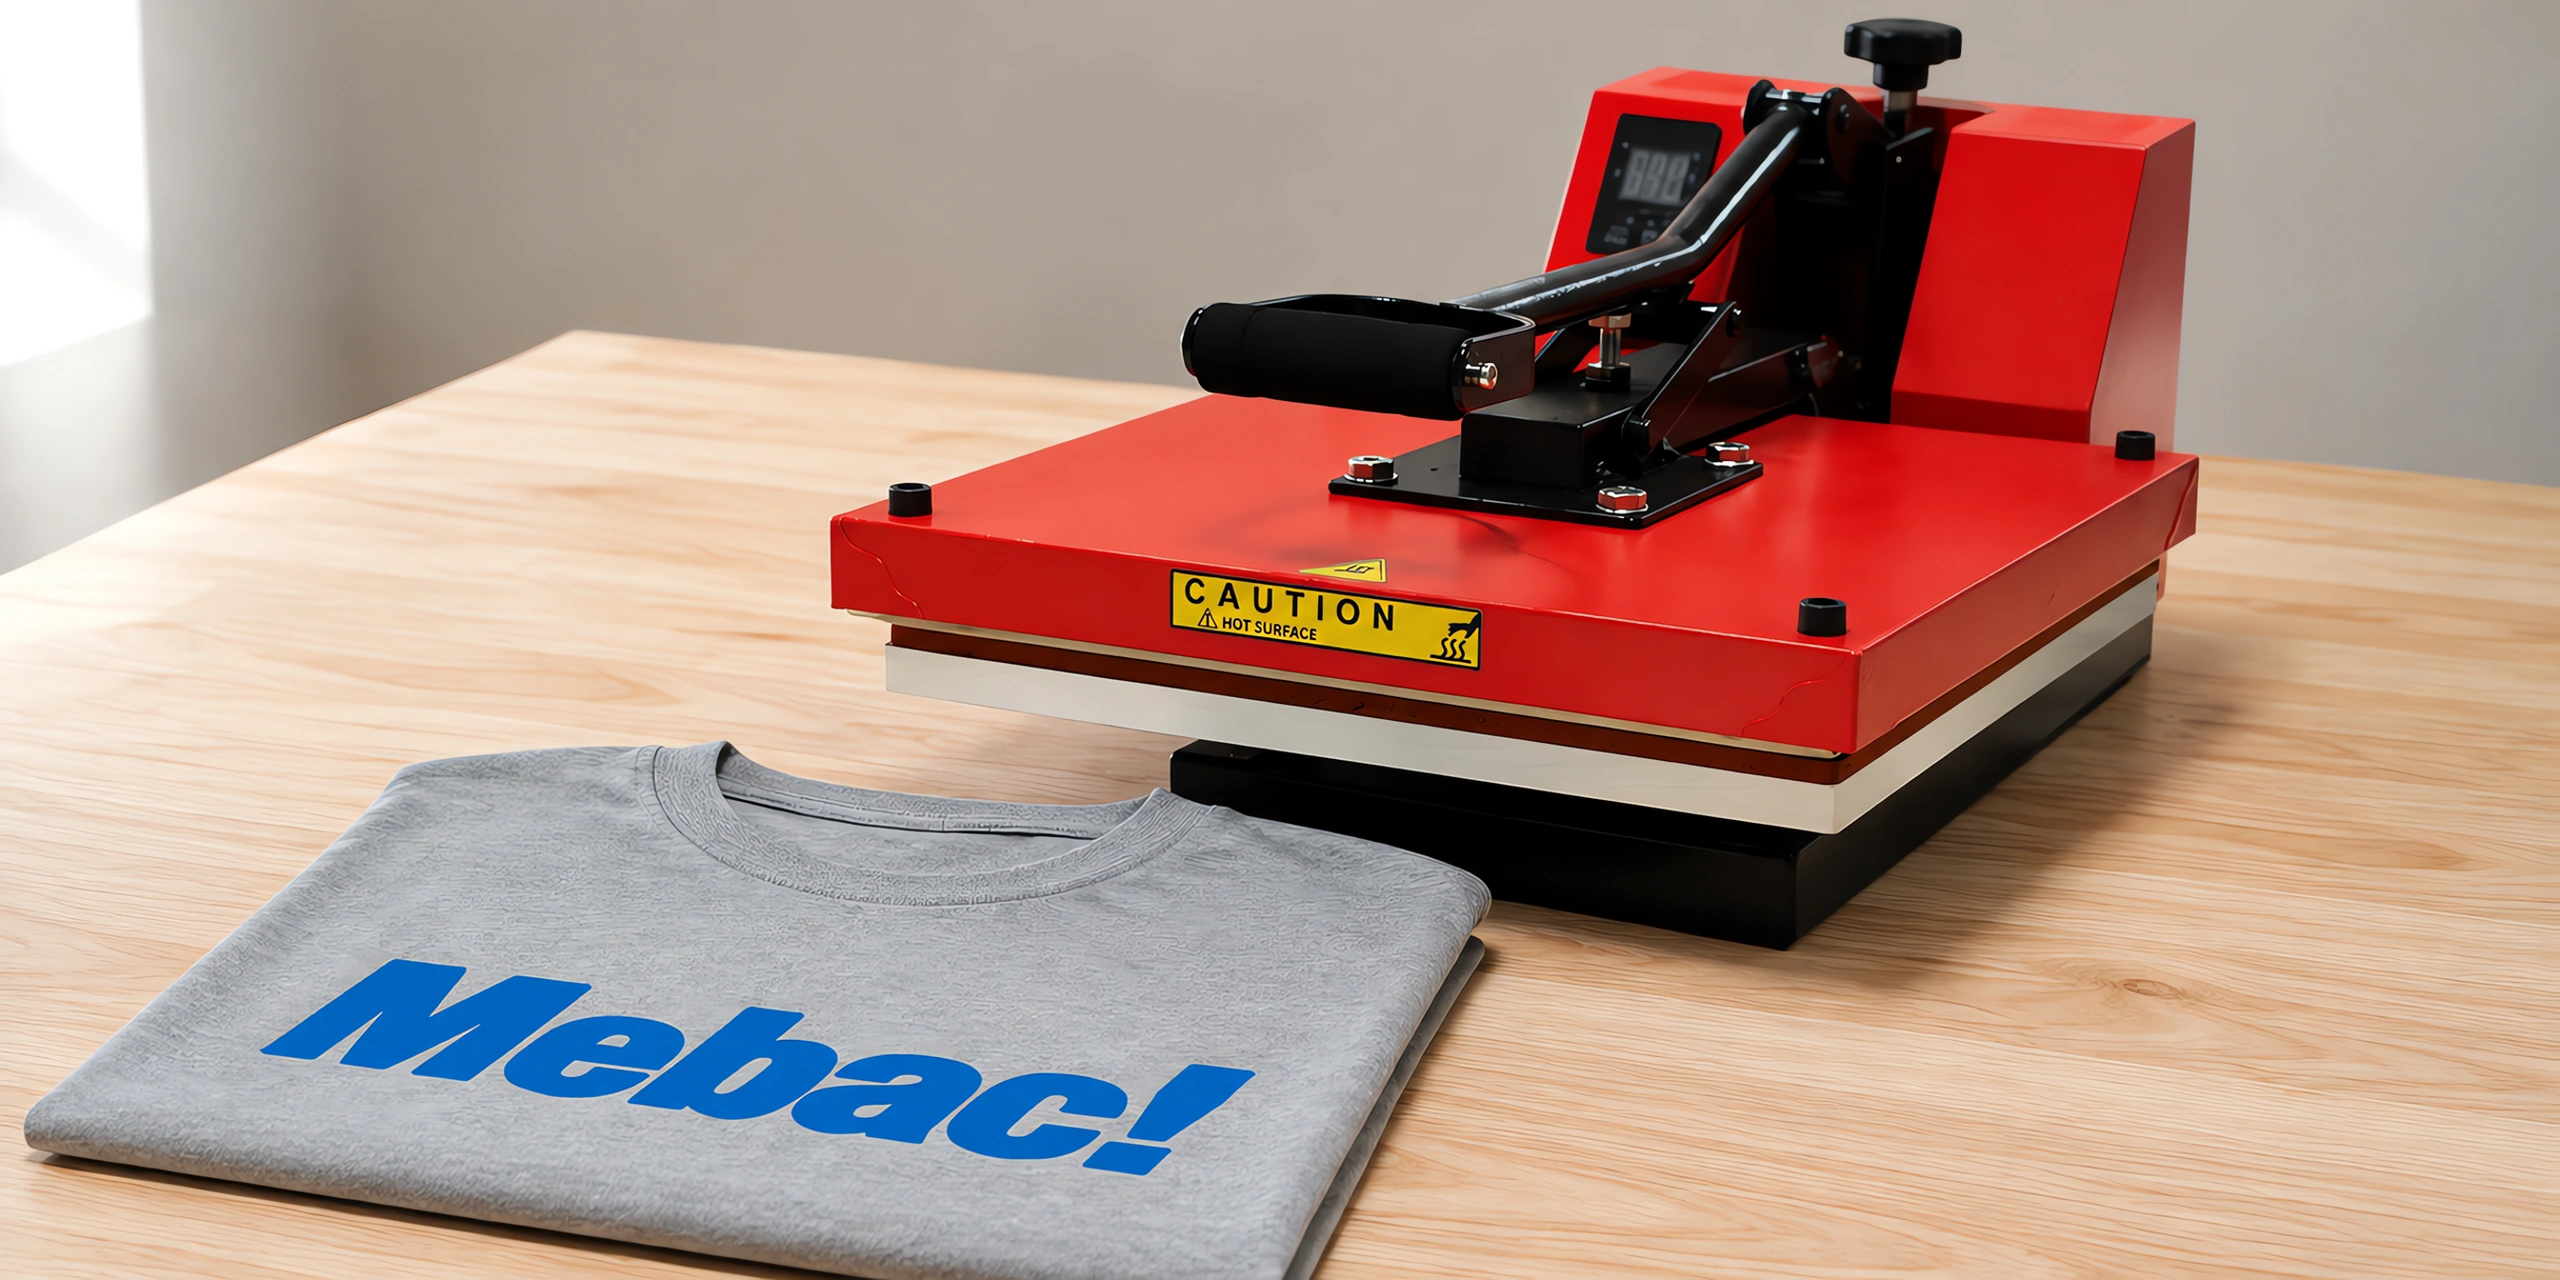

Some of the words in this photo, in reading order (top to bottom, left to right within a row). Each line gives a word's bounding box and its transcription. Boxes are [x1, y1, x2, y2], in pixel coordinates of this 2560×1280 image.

[1184, 577, 1395, 631] CAUTION
[1222, 616, 1252, 633] HOT
[1254, 620, 1317, 641] SURFACE
[260, 958, 1256, 1177] Mebac!
